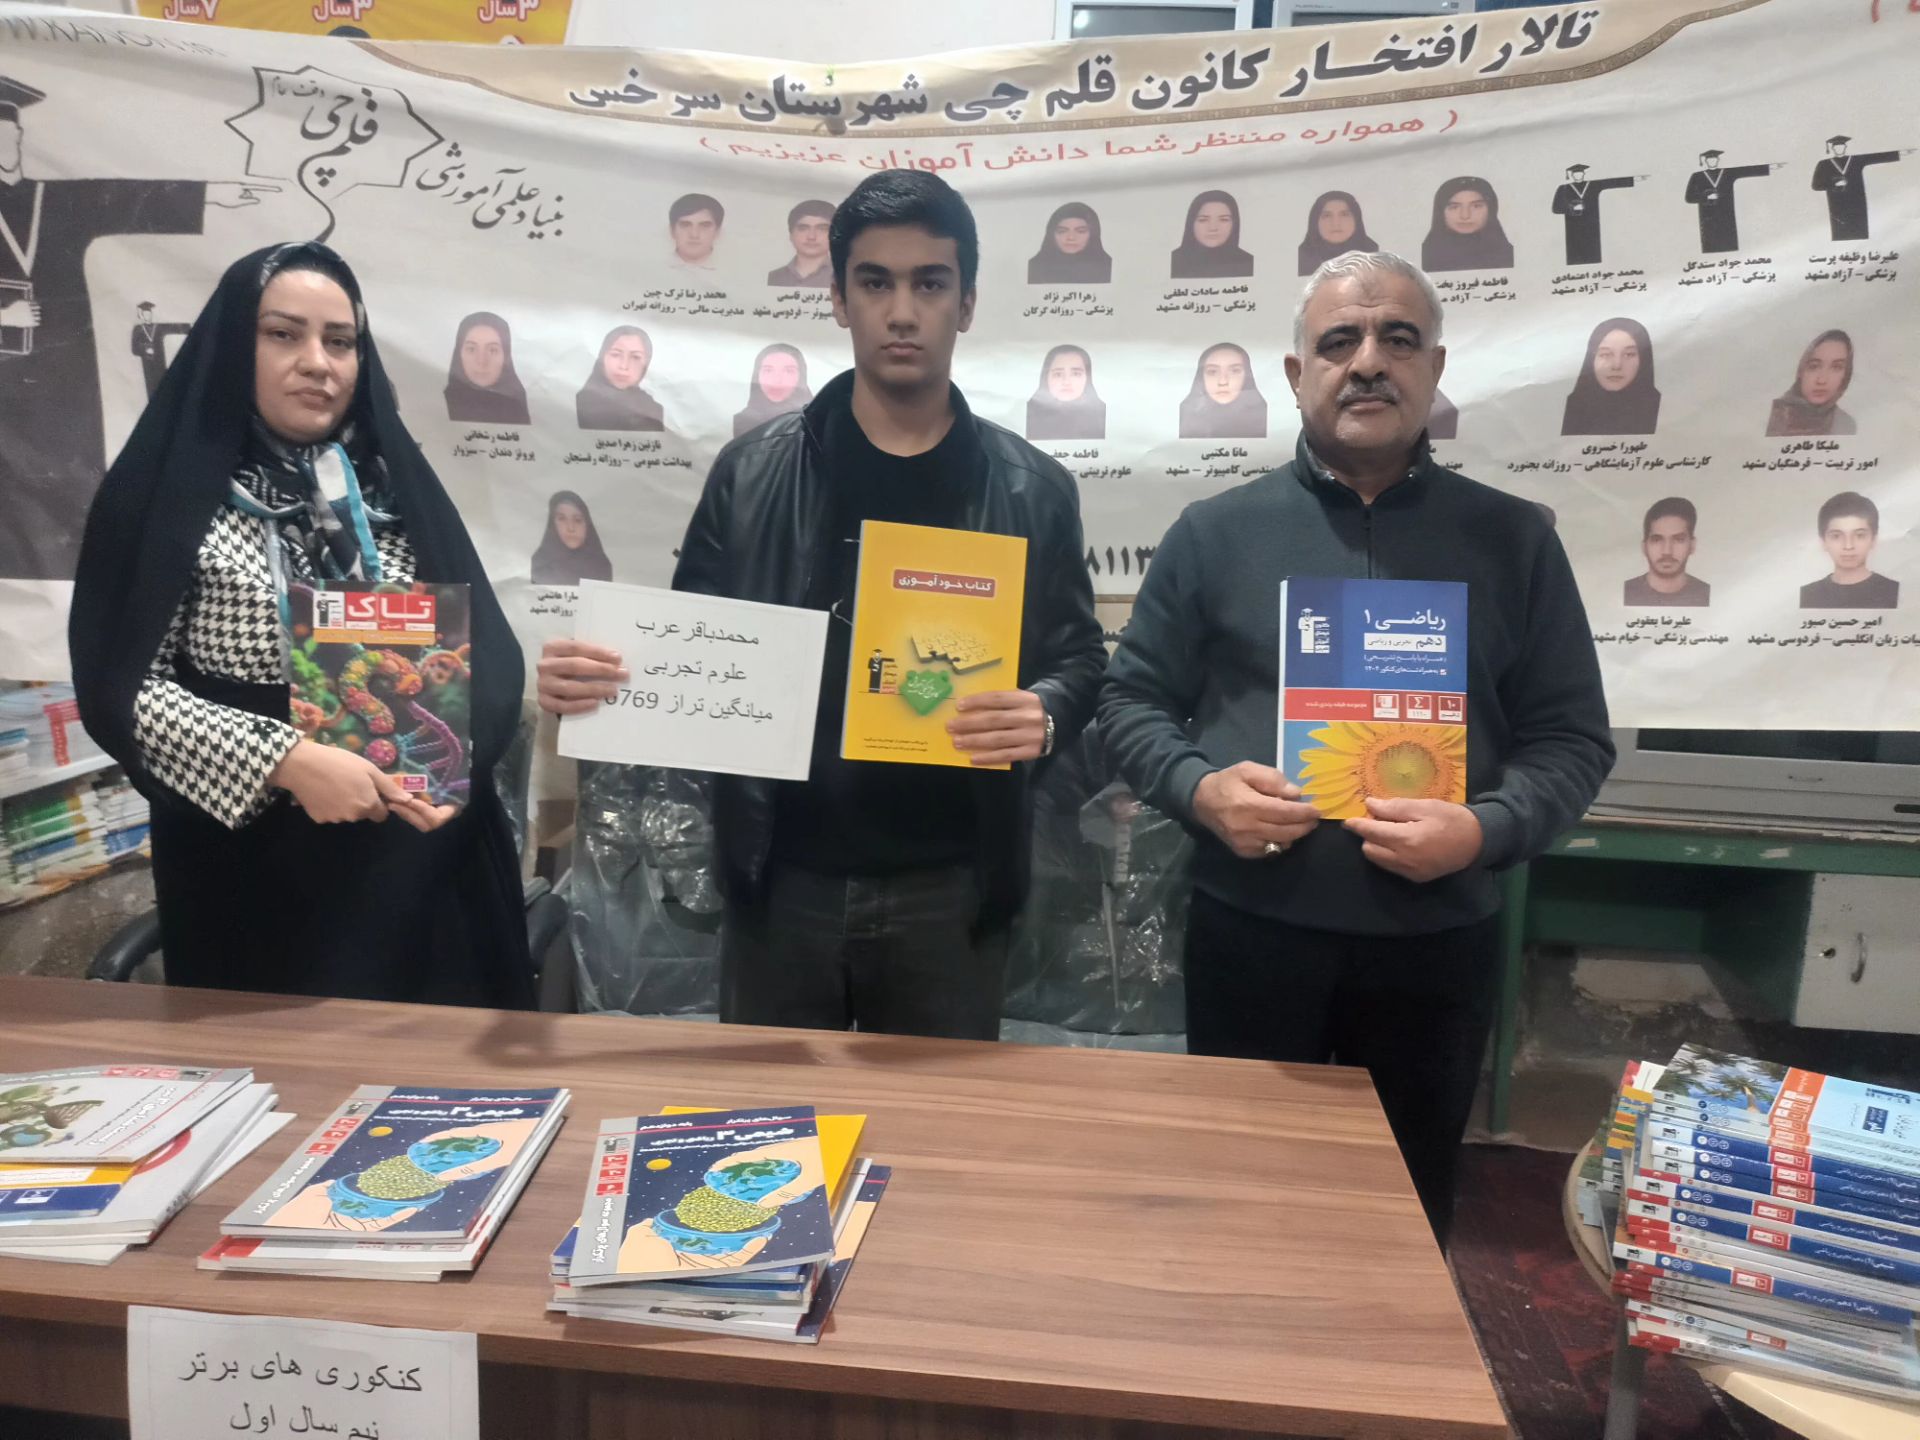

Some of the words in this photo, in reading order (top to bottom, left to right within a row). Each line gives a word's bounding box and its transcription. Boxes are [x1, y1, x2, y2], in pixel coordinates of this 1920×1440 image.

[1479, 10, 1600, 74] تالار
[1279, 23, 1478, 98] افتخار
[1131, 47, 1270, 111] کانون
[1046, 55, 1116, 118] قلم
[944, 82, 1030, 120] چی
[1300, 118, 1425, 145] همواره
[1106, 134, 1177, 157] شما
[1182, 128, 1286, 154] منتظر
[858, 143, 974, 175] آموزان
[984, 137, 1089, 170] دانش
[1717, 257, 1741, 269] جواد
[1744, 255, 1772, 266] محمد
[1868, 250, 1899, 263] علیرضا
[1591, 270, 1614, 281] جواد
[1616, 268, 1643, 278] محمد
[1705, 272, 1727, 285] آزاد
[1742, 272, 1776, 284] پزشکی
[1804, 269, 1830, 281] مشهد
[1831, 268, 1854, 281] آزاد
[1864, 268, 1897, 282] پزشکی
[1481, 276, 1508, 288] فاطمه
[1613, 281, 1647, 294] پزشکی
[1678, 275, 1704, 286] مشهد
[1191, 287, 1220, 298] سادات
[1222, 284, 1249, 296] فاطمه
[1550, 285, 1580, 296] مشهد
[1581, 283, 1601, 296] آزاد
[1452, 293, 1471, 304] آزاد
[1481, 290, 1516, 304] پزشکی
[1156, 303, 1181, 314] مشهد
[1182, 301, 1211, 314] روزانه
[1223, 299, 1256, 313] پزشکی
[1074, 448, 1099, 460] فاطمه
[1581, 442, 1618, 456] خسروی
[1541, 459, 1572, 473] روزانه
[1642, 457, 1664, 471] علوم
[1666, 455, 1711, 470] کارشناسی
[1742, 459, 1766, 470] مشهد
[1857, 458, 1879, 471] امور
[1110, 466, 1132, 479] علوم
[1165, 465, 1190, 475] مشهد
[965, 580, 993, 593] کتاب
[1374, 608, 1447, 632] ریاضی
[1660, 616, 1692, 629] علیرضا
[636, 619, 681, 639] عرب
[682, 621, 760, 646] محمدباقر
[1653, 634, 1687, 648] پزشکی
[1688, 634, 1729, 647] مهندسی
[1747, 634, 1776, 646] مشهد
[643, 660, 703, 683] تجربی
[706, 662, 748, 684] علوم
[665, 693, 705, 717] تراز
[708, 696, 774, 723] میانگین
[248, 1350, 302, 1380] های
[314, 1364, 424, 1394] کنکوری
[229, 1401, 278, 1434] اول
[288, 1404, 339, 1434] سال
